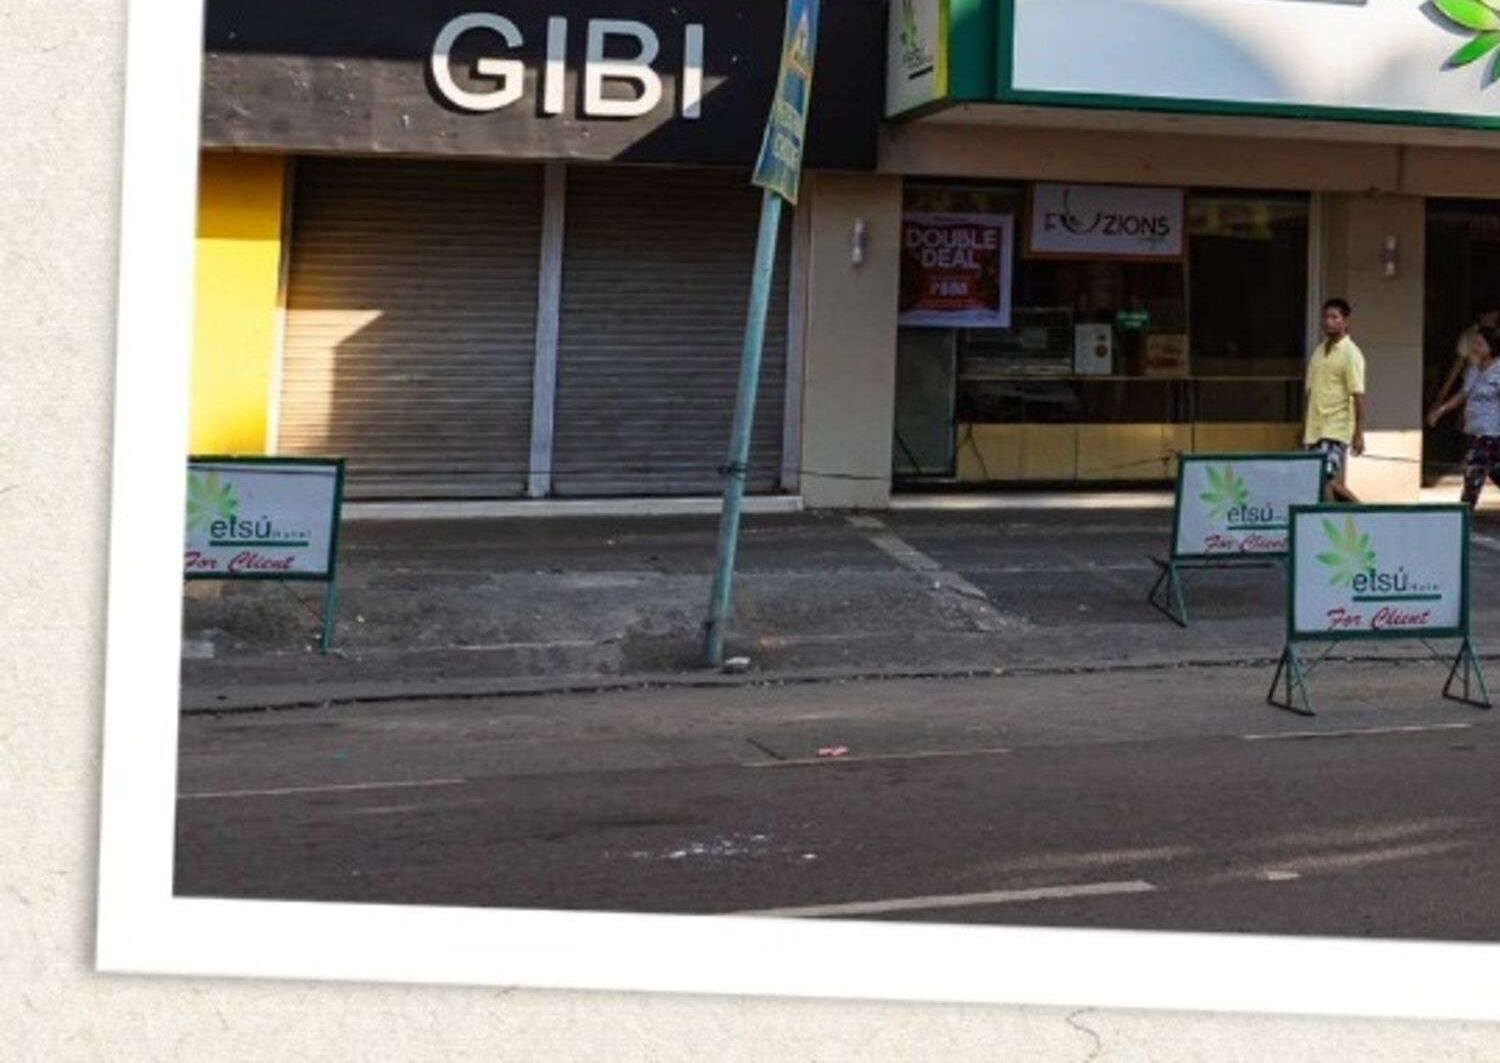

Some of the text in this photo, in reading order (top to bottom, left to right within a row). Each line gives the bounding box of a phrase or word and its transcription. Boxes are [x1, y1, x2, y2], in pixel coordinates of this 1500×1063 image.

[431, 12, 704, 119] GIBI
[905, 228, 998, 250] DOUBLE
[921, 249, 981, 269] DEAL
[210, 515, 272, 539] etsú
[228, 550, 296, 572] Client
[1353, 567, 1408, 592] etsú
[1327, 607, 1431, 631] For Client
